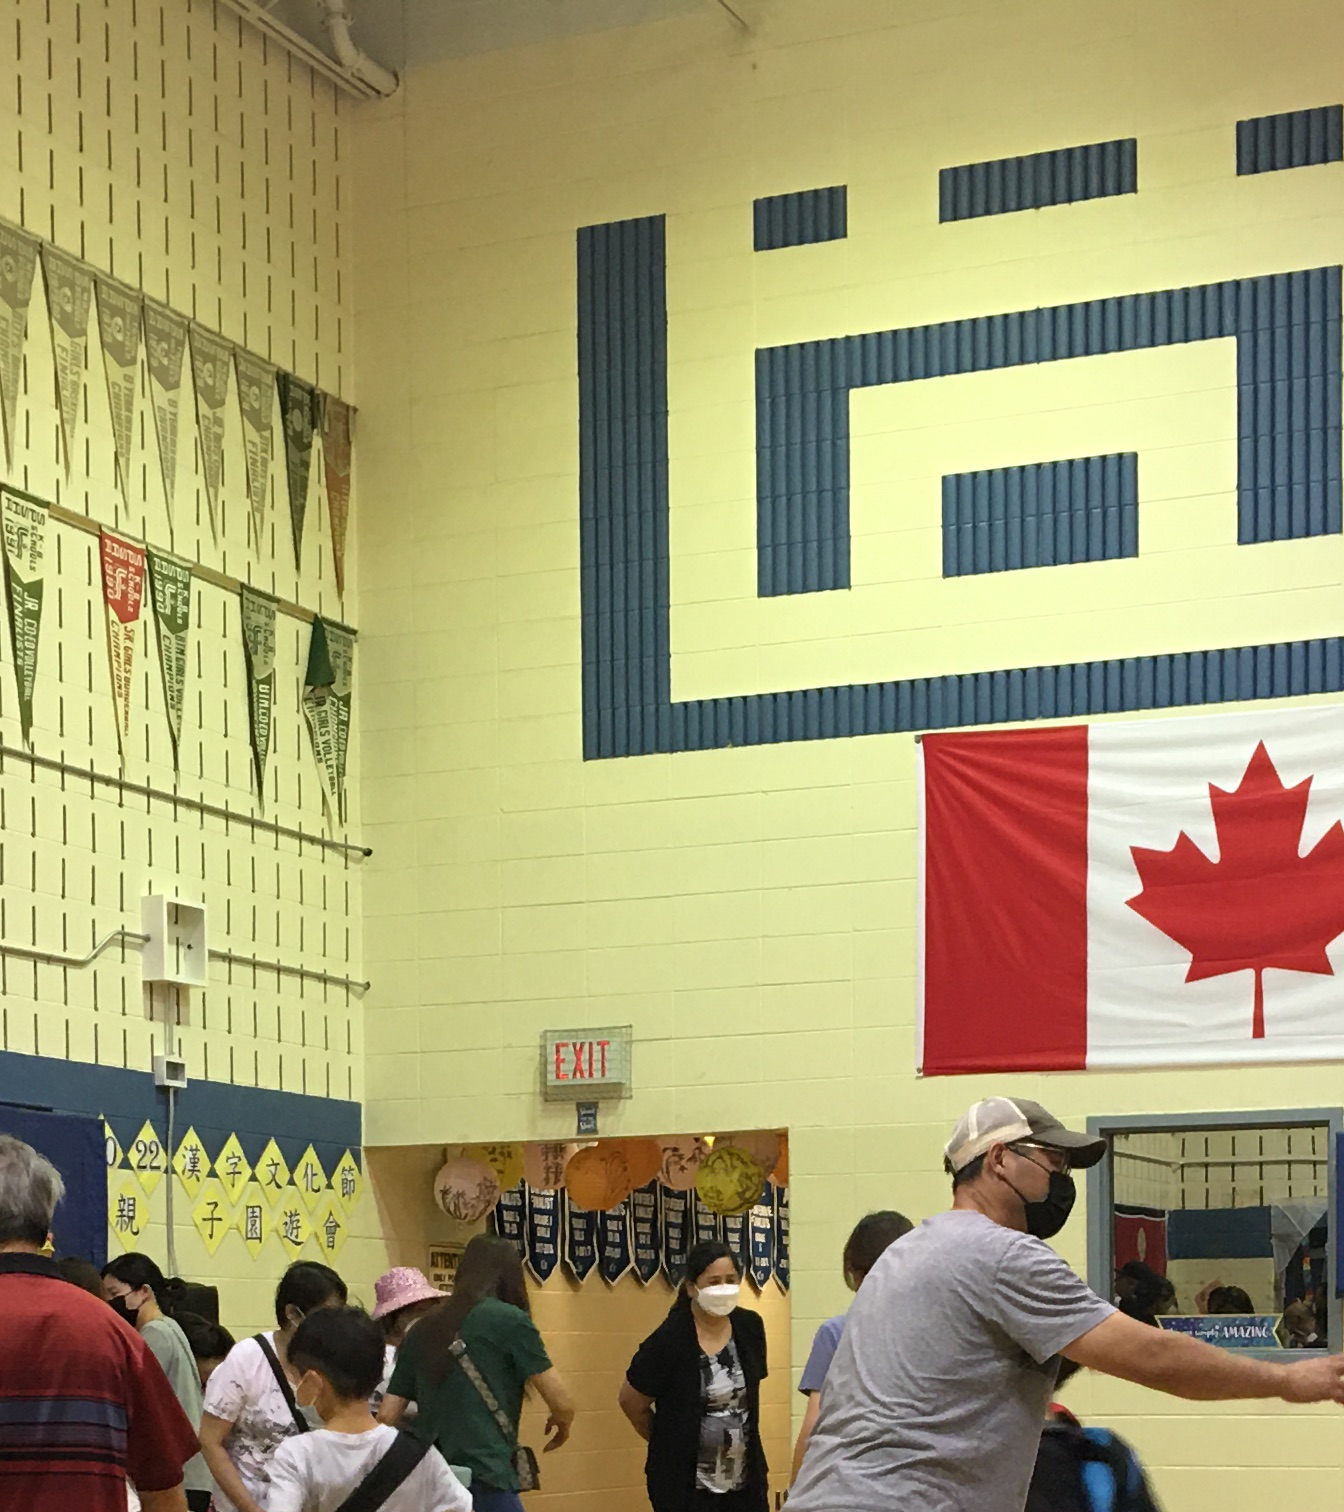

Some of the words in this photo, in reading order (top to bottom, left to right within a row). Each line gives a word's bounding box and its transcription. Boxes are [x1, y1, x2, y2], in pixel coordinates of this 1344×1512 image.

[70, 341, 83, 376] GIRLS
[111, 381, 125, 459] CHAMPIONS
[4, 517, 17, 553] 1991
[29, 525, 39, 573] SCHOOLS
[36, 533, 44, 559] K-8
[105, 556, 115, 601] 1990
[127, 566, 137, 613] SCHOOLS
[154, 574, 165, 614] 1990
[12, 582, 24, 667] FINALISTS
[176, 582, 185, 625] SCHOOLS
[23, 618, 38, 648] CO-ED
[23, 648, 35, 702] VOLLEYBALL
[111, 619, 124, 699] CHAMPIONS
[123, 646, 134, 673] GIRLS
[162, 633, 175, 711] CHAMPIONS
[175, 657, 186, 686] GIRLS
[316, 710, 330, 737] GIRLS
[321, 738, 336, 796] VOLLEYBALL
[555, 1040, 610, 1080] EXIT
[181, 1144, 356, 1203] 漢字文化節
[115, 1192, 341, 1251] 親子園遊會
